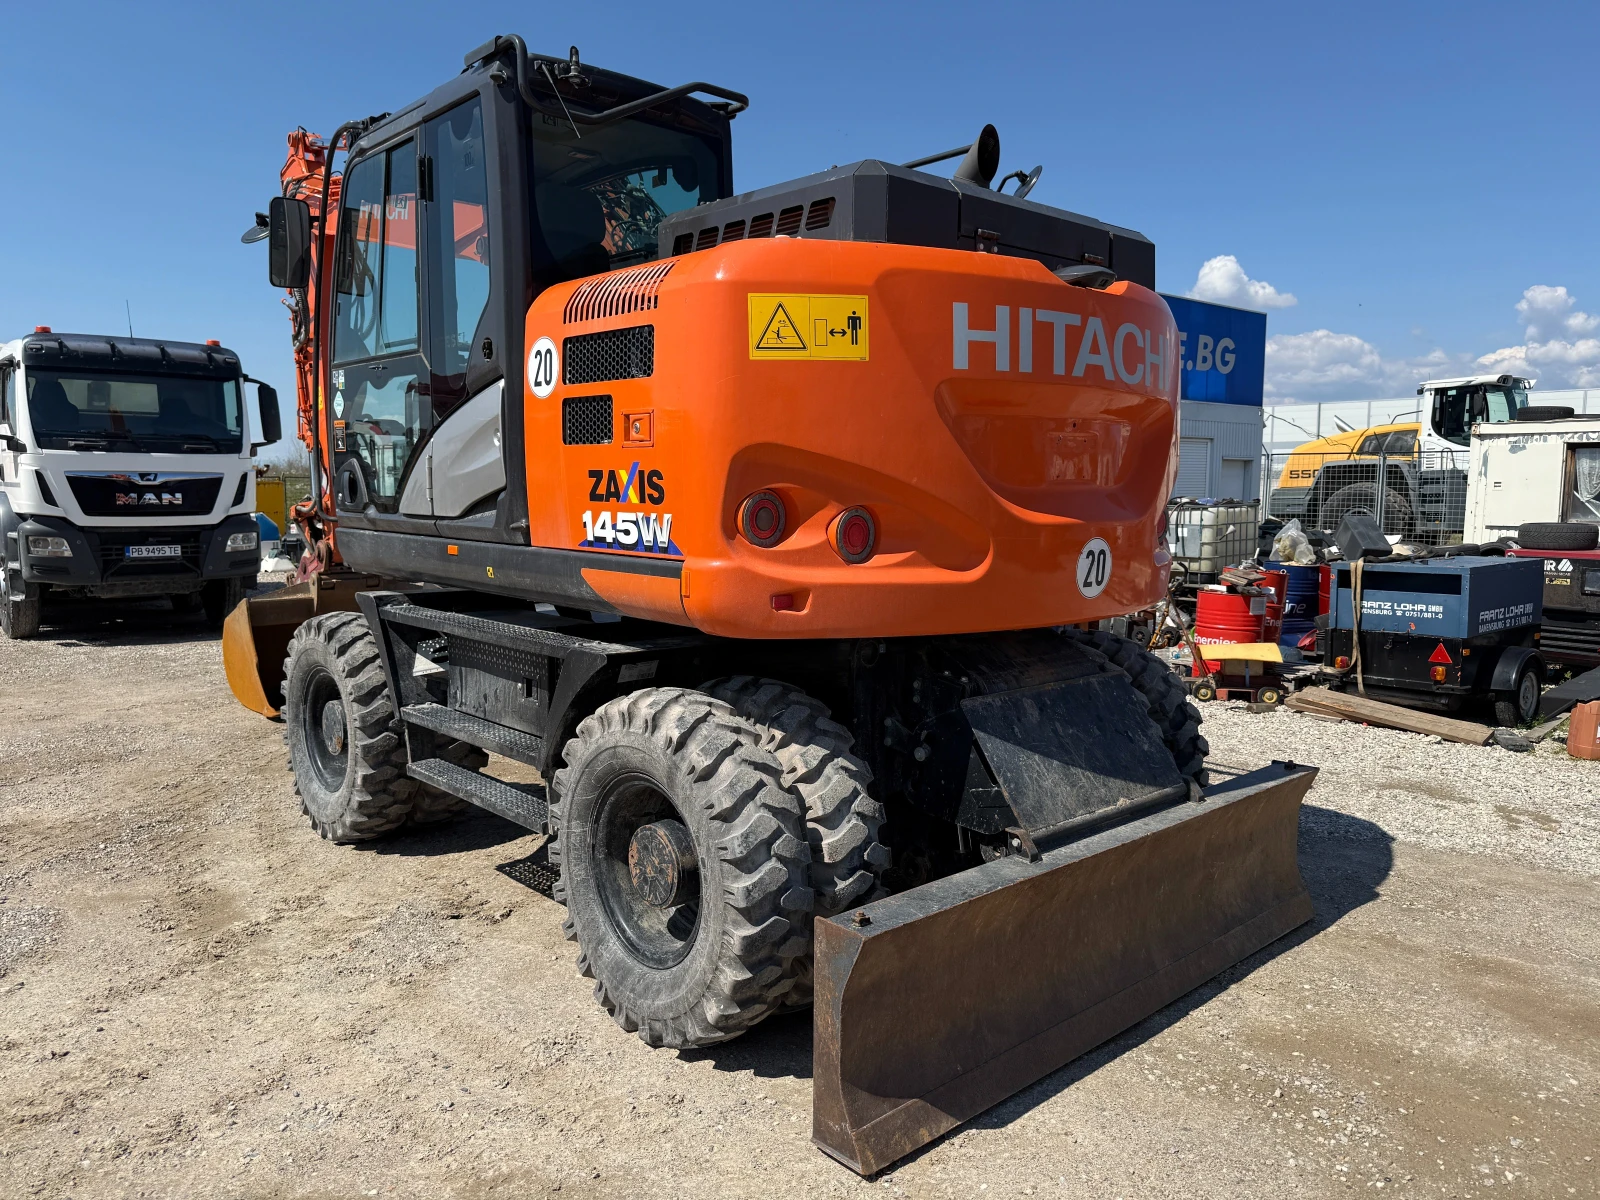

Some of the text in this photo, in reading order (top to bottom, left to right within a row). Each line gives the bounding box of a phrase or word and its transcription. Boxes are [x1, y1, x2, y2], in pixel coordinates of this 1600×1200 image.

[953, 302, 1170, 392] HITACHI
[1180, 332, 1236, 375] E.BG
[534, 348, 552, 387] 20
[588, 461, 665, 505] ZAXIS
[116, 493, 182, 505] MAN
[582, 510, 672, 549] 145W
[131, 547, 144, 556] PB
[145, 547, 167, 556] 9495
[168, 546, 180, 555] TE
[1083, 549, 1107, 588] 20
[1283, 600, 1306, 614] ine
[1361, 601, 1392, 609] RANZ
[1394, 603, 1426, 612] LOHR
[1361, 608, 1393, 616] VENSBURG
[1479, 608, 1505, 622] FRANZ
[1505, 605, 1525, 618] LOHR
